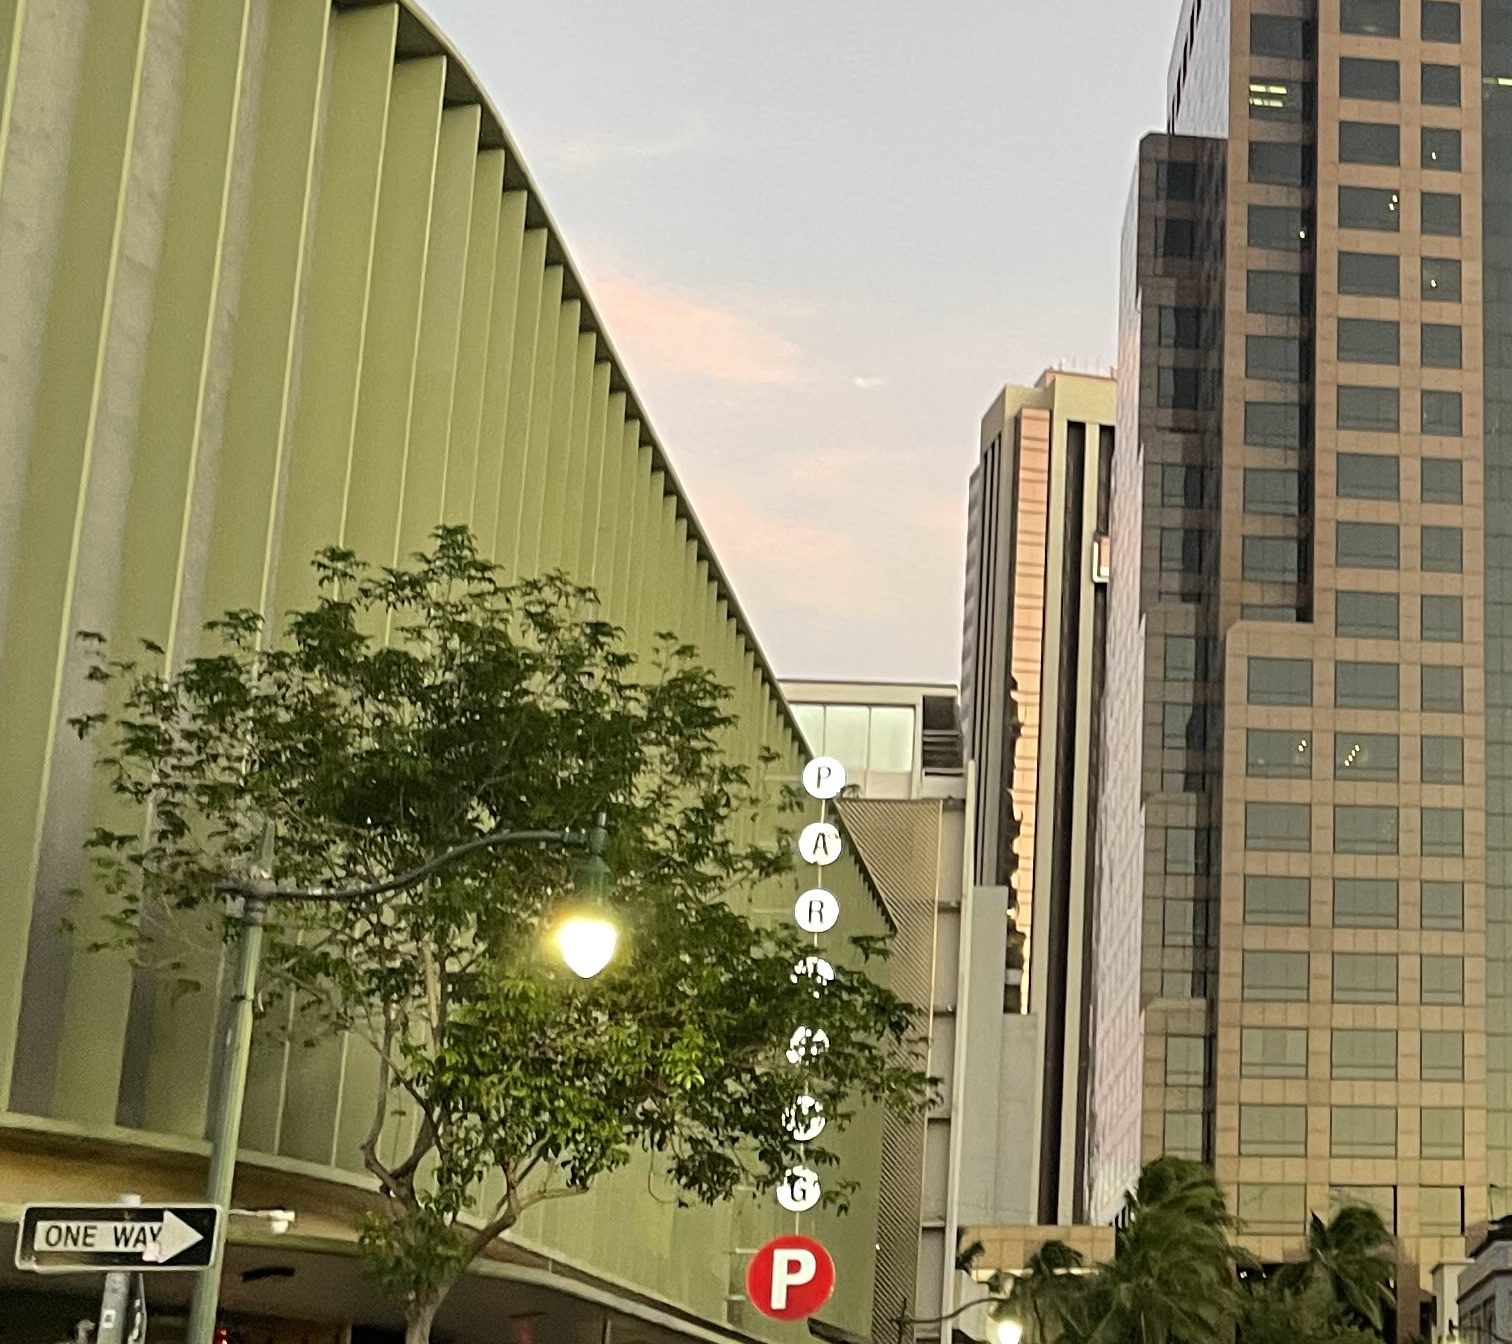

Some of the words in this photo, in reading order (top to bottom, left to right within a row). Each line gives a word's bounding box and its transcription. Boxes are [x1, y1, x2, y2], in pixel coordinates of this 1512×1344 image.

[45, 1224, 98, 1248] ONE
[113, 1224, 163, 1249] WAY
[770, 1248, 817, 1311] P
